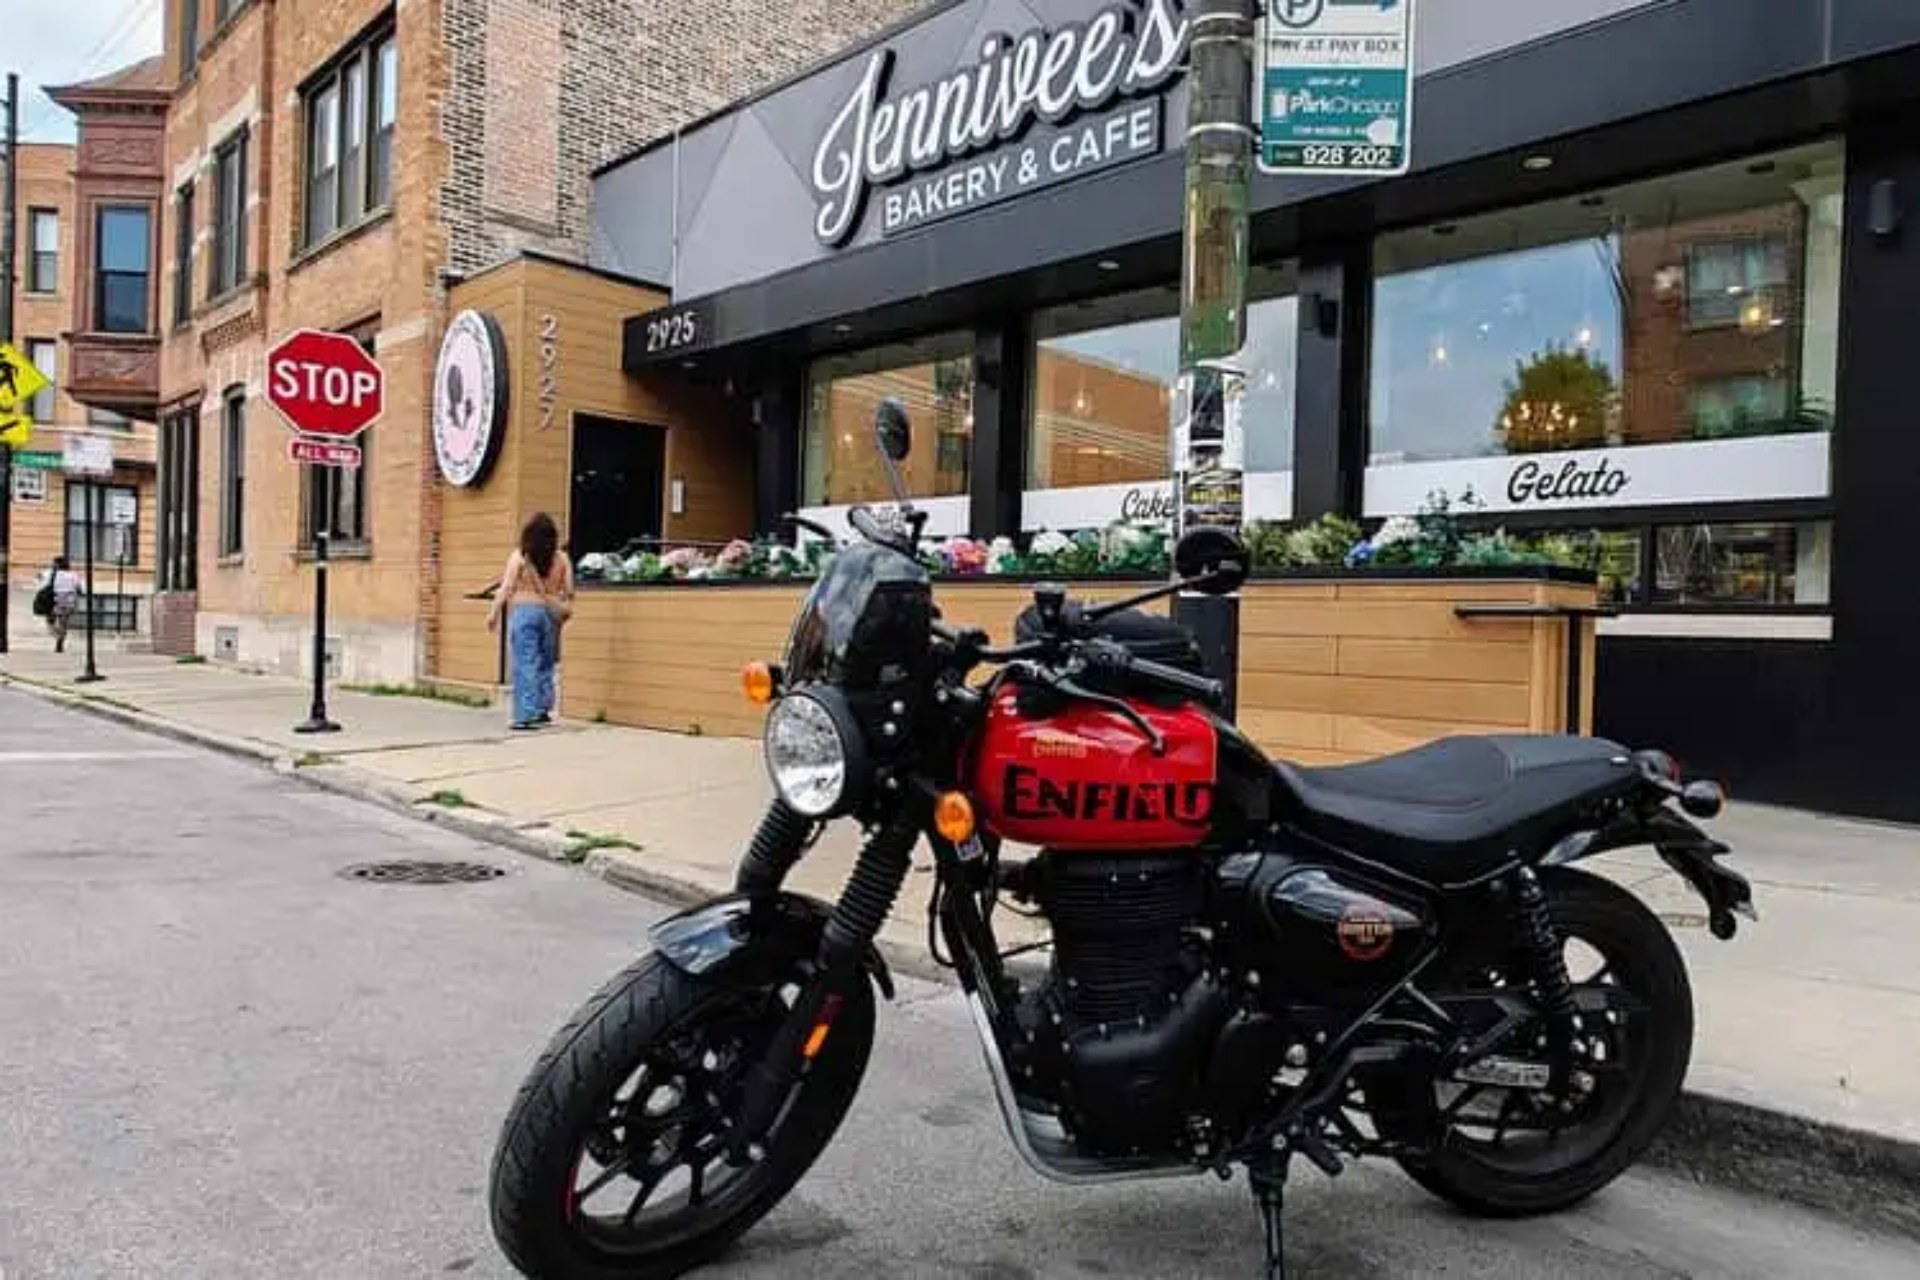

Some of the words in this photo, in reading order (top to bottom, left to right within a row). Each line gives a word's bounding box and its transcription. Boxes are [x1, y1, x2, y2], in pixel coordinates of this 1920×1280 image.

[1329, 39, 1359, 51] PAY
[812, 0, 1190, 238] Jennivees
[884, 159, 1011, 228] BAKERY
[1016, 149, 1039, 183] &
[1049, 107, 1153, 172] CAFE
[1350, 147, 1391, 165] 202
[646, 311, 696, 352] 2925
[273, 358, 376, 408] STOP
[539, 313, 558, 430] 2927
[1507, 457, 1631, 503] Gelato
[1003, 764, 1215, 827] ENFIELD
